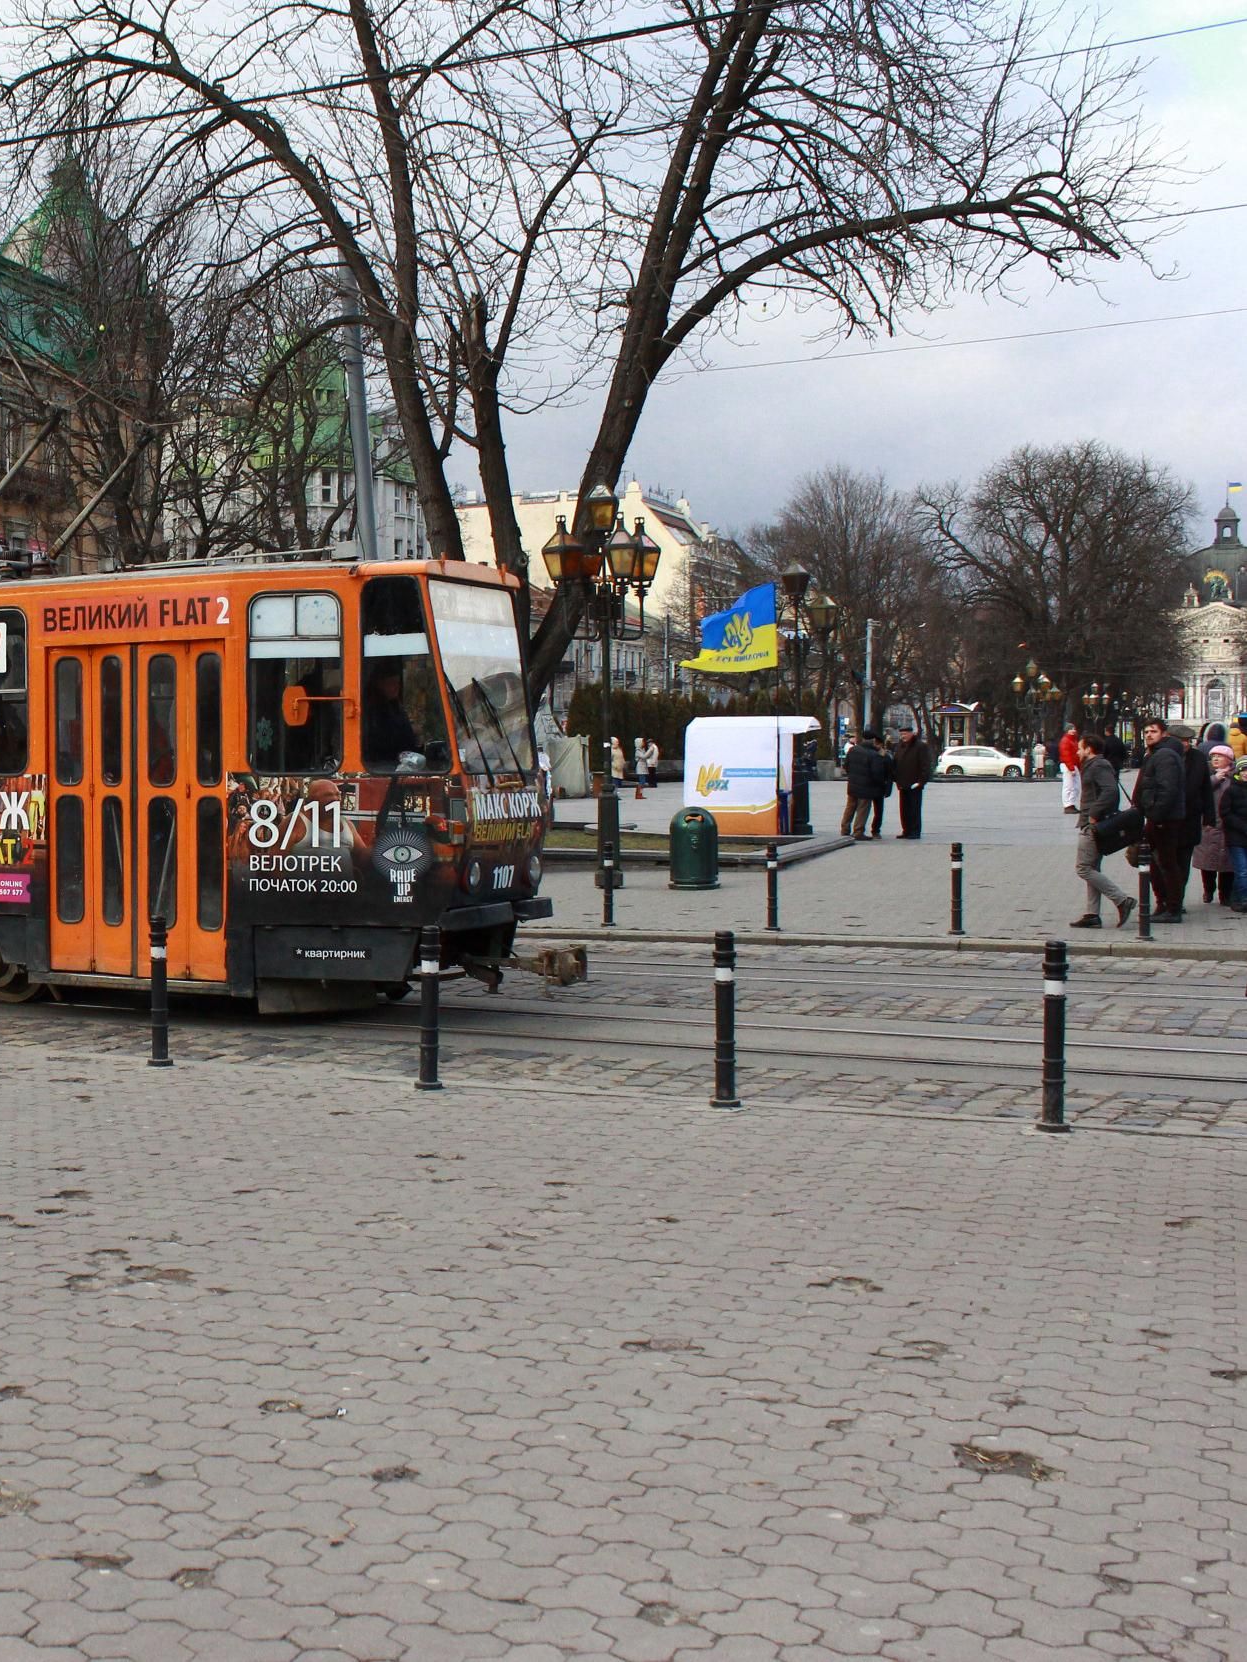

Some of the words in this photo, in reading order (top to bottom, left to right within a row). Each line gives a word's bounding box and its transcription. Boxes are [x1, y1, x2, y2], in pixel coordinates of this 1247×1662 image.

[44, 595, 148, 632] ВЕЛИКИЙ
[159, 597, 210, 626] FLAT
[216, 596, 229, 624] 2
[475, 792, 509, 820] МАКС
[507, 792, 542, 818] КОРЖ
[248, 798, 342, 850] 8/11
[249, 855, 342, 872] ВЕЛОТРЕК
[249, 878, 317, 892] ПОЧАТОК
[320, 879, 358, 893] 20:00
[492, 865, 515, 889] 1107
[397, 883, 411, 896] UP
[304, 949, 366, 960] квартирник
